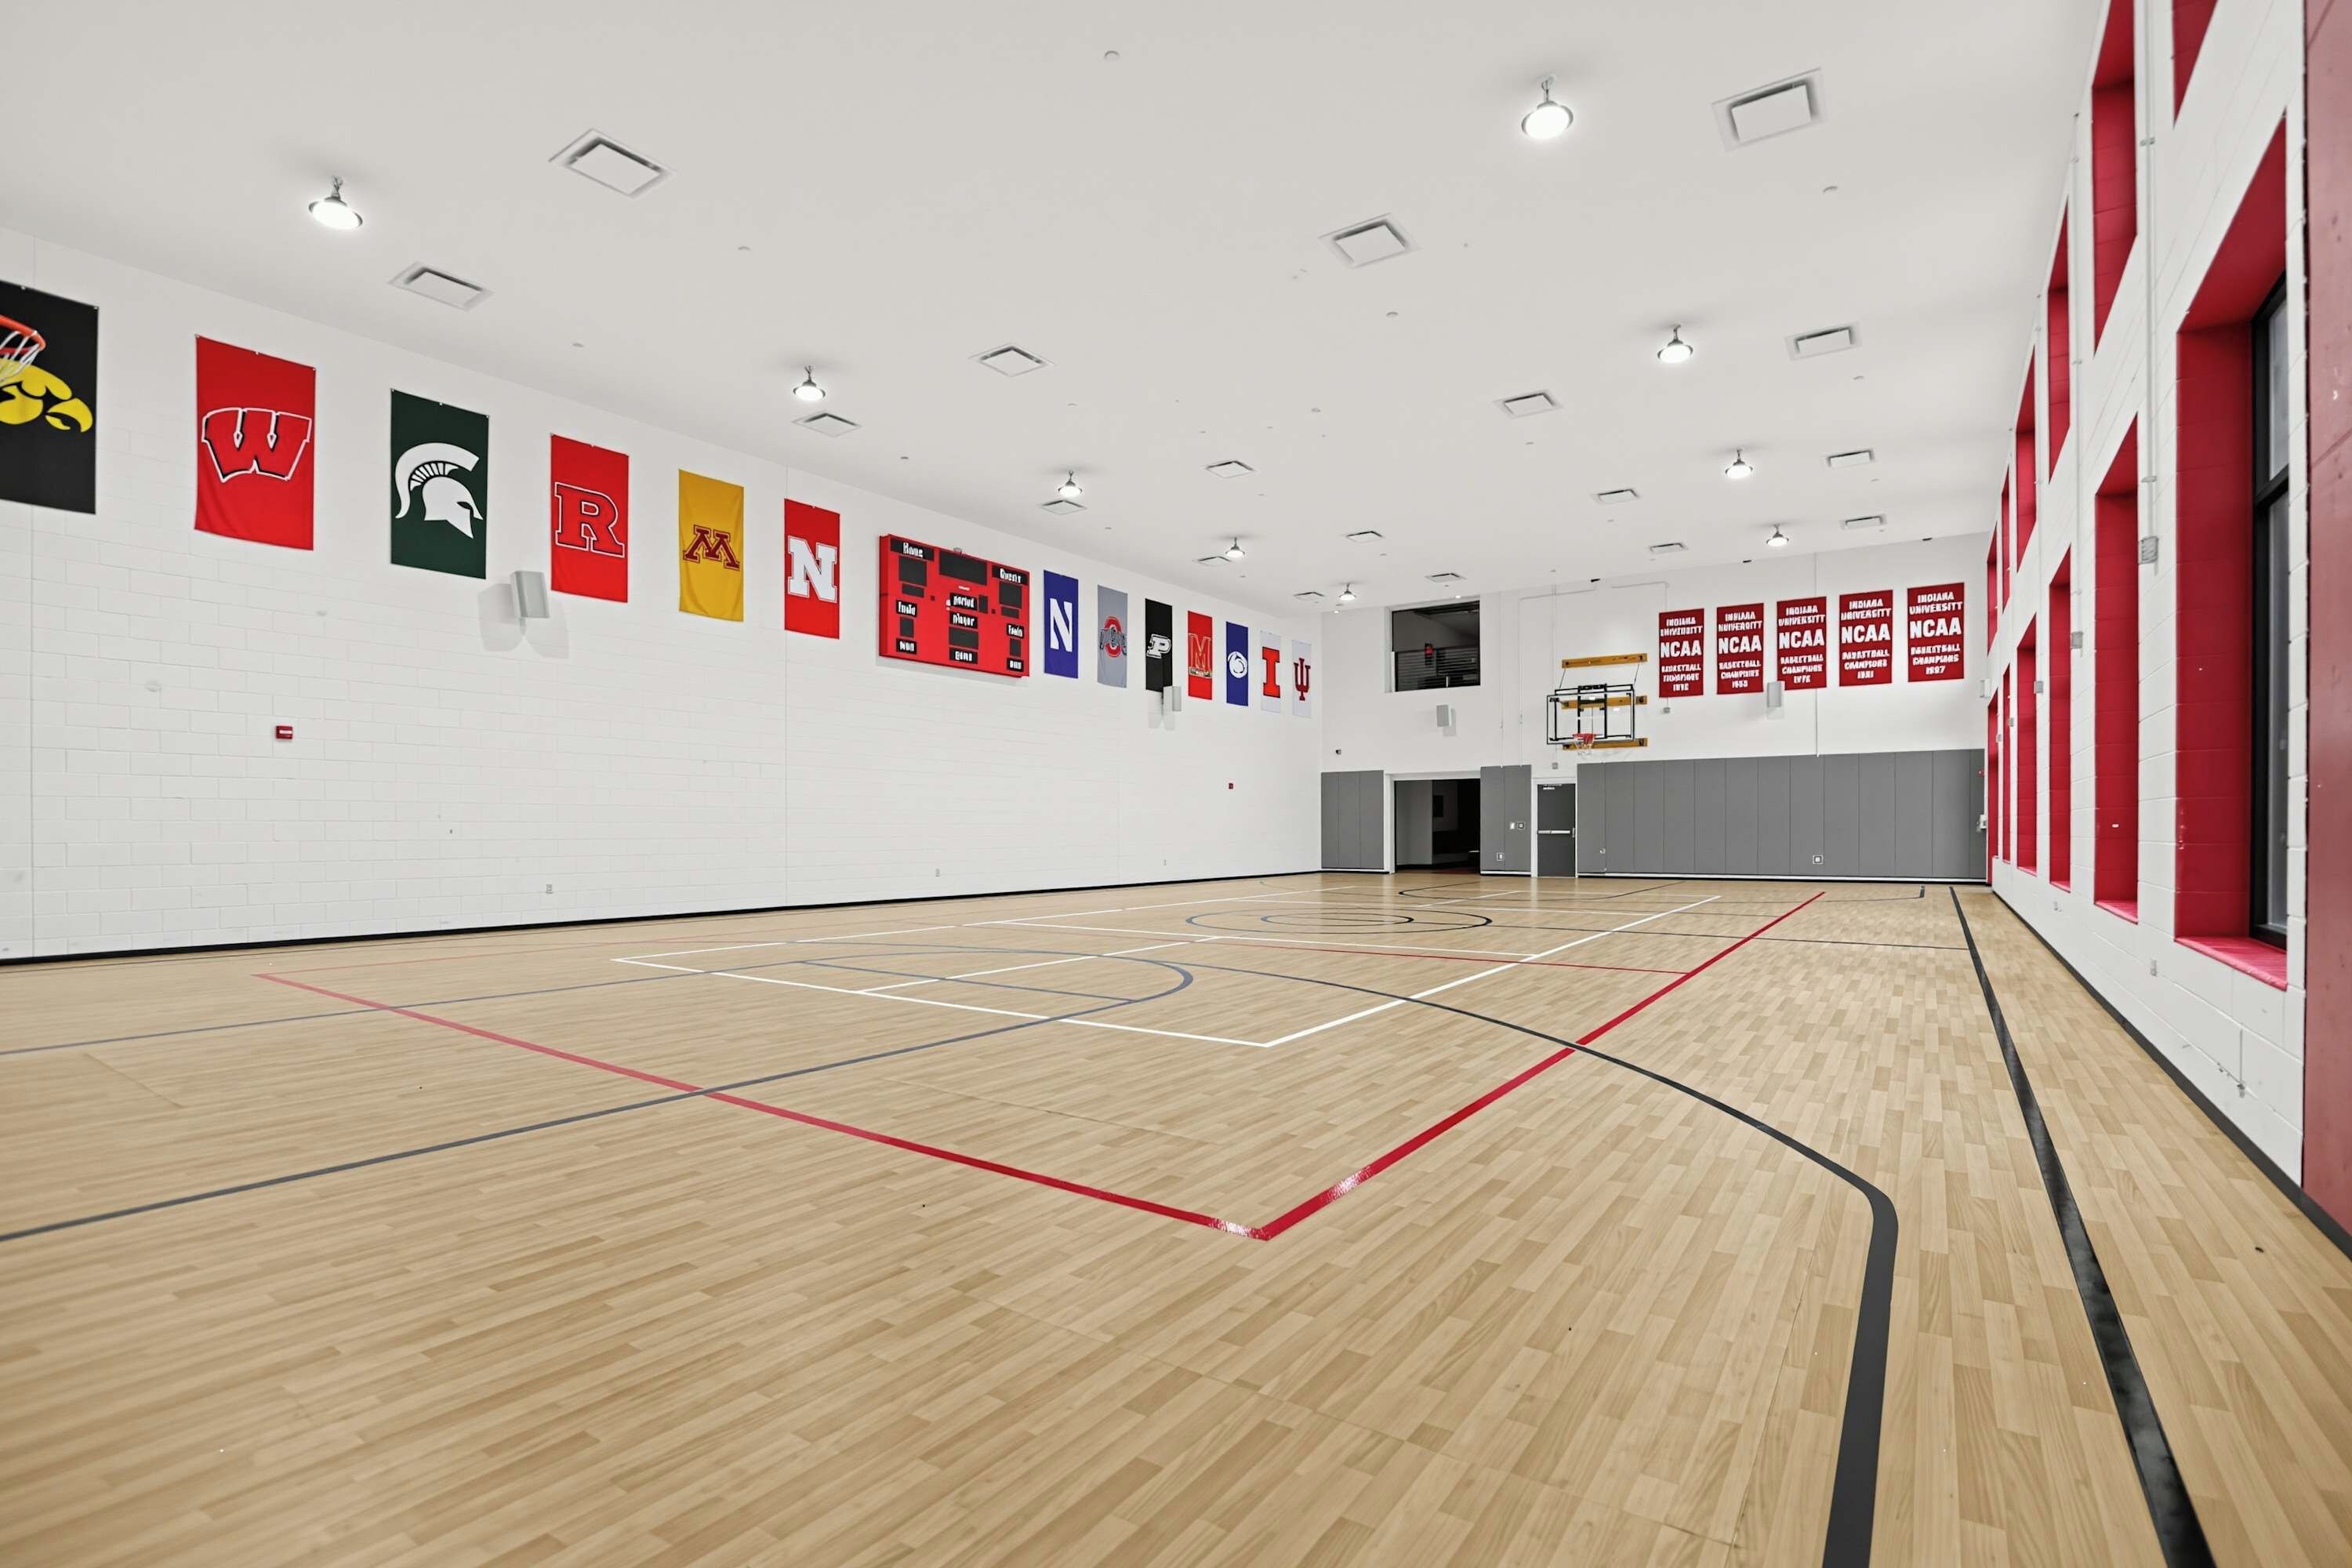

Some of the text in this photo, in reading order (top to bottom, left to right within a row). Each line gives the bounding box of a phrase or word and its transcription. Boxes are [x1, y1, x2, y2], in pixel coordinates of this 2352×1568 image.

[201, 406, 312, 483] W
[554, 481, 626, 558] R
[683, 524, 740, 572] M
[787, 535, 838, 604] N
[1849, 598, 1882, 609] INDIANA
[1917, 591, 1954, 603] INDIANA
[1841, 608, 1891, 620] UNIVERSITY
[1909, 601, 1962, 615] UNIVERSITY
[1049, 598, 1073, 653] N
[1778, 614, 1825, 626] UNIVERSITY
[1910, 617, 1962, 638] NCAA
[1718, 634, 1762, 654] NCAA
[1779, 628, 1824, 649] NCAA
[1841, 623, 1890, 644] NCAA
[1146, 633, 1172, 659] P
[1660, 640, 1701, 658] NCAA
